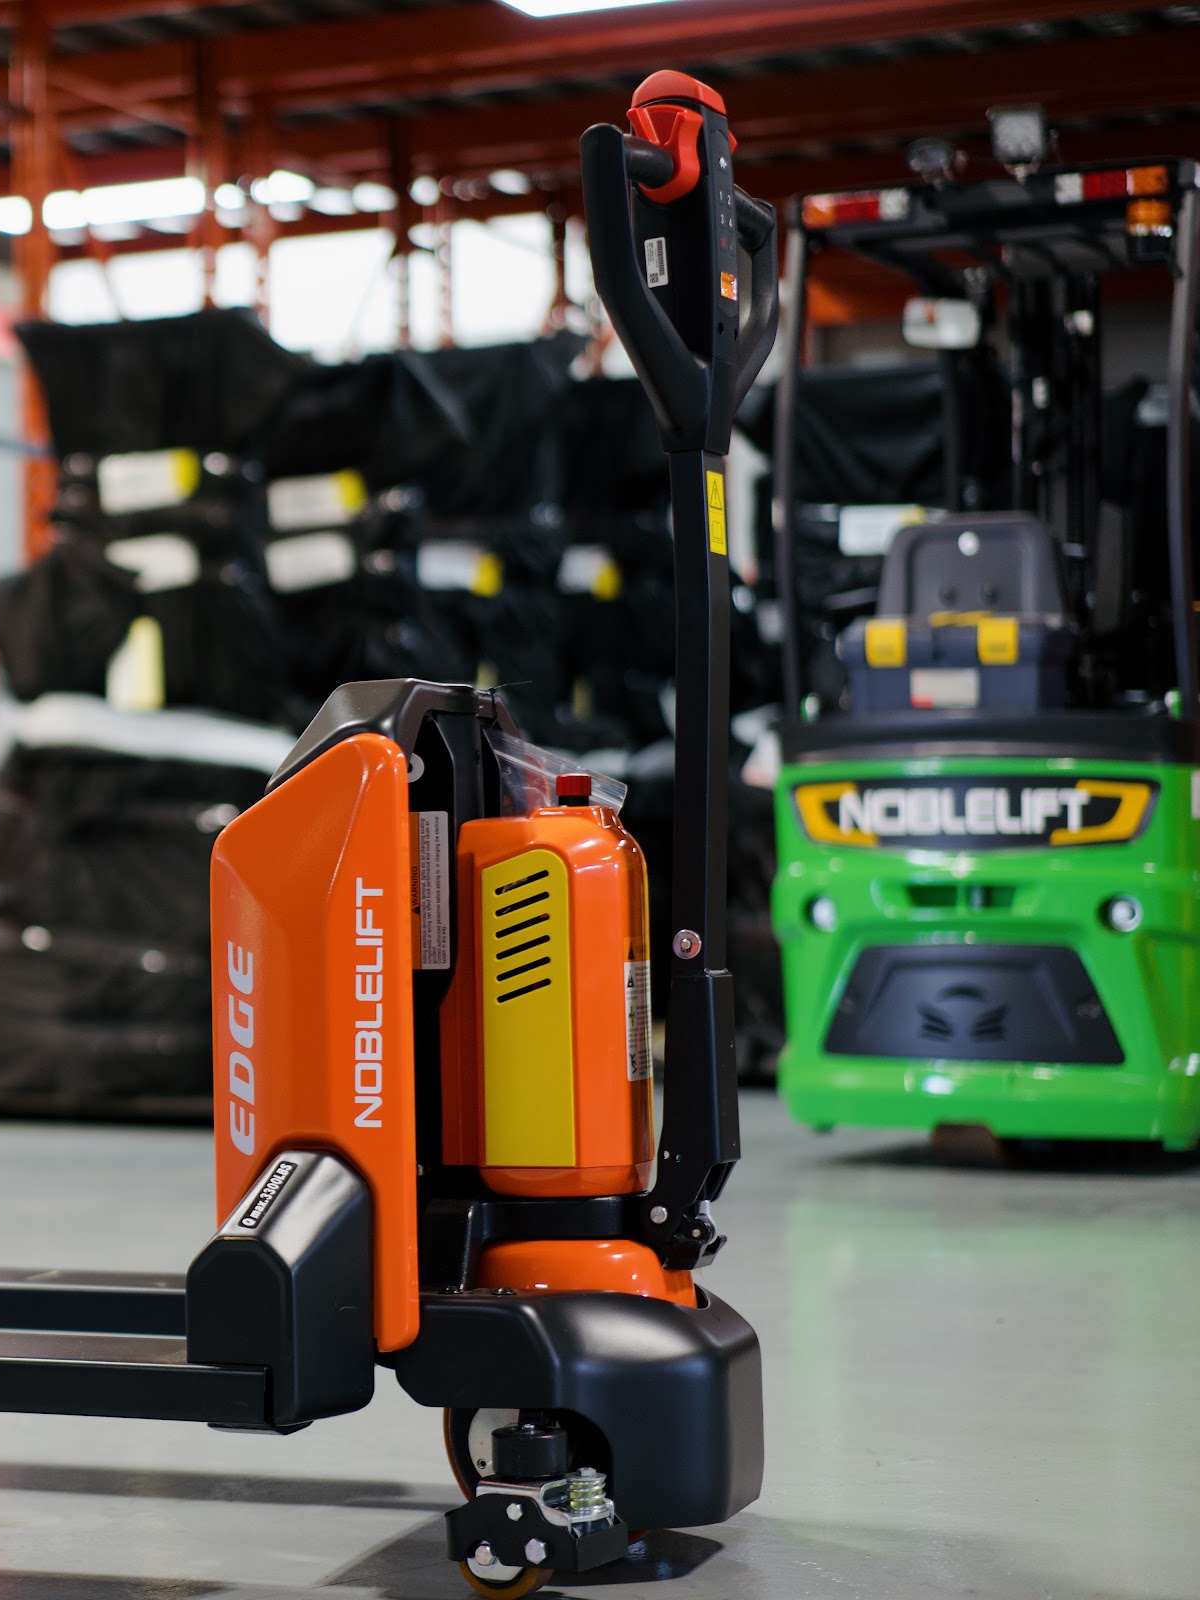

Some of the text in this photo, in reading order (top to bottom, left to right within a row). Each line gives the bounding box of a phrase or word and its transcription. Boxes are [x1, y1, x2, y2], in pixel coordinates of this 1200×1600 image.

[727, 195, 731, 205] 2
[720, 214, 732, 228] 3 4
[839, 787, 1090, 836] NOBLELIFT
[353, 877, 383, 1128] NOBLELIFT
[227, 940, 255, 1156] EDGE
[242, 1217, 257, 1227] Q
